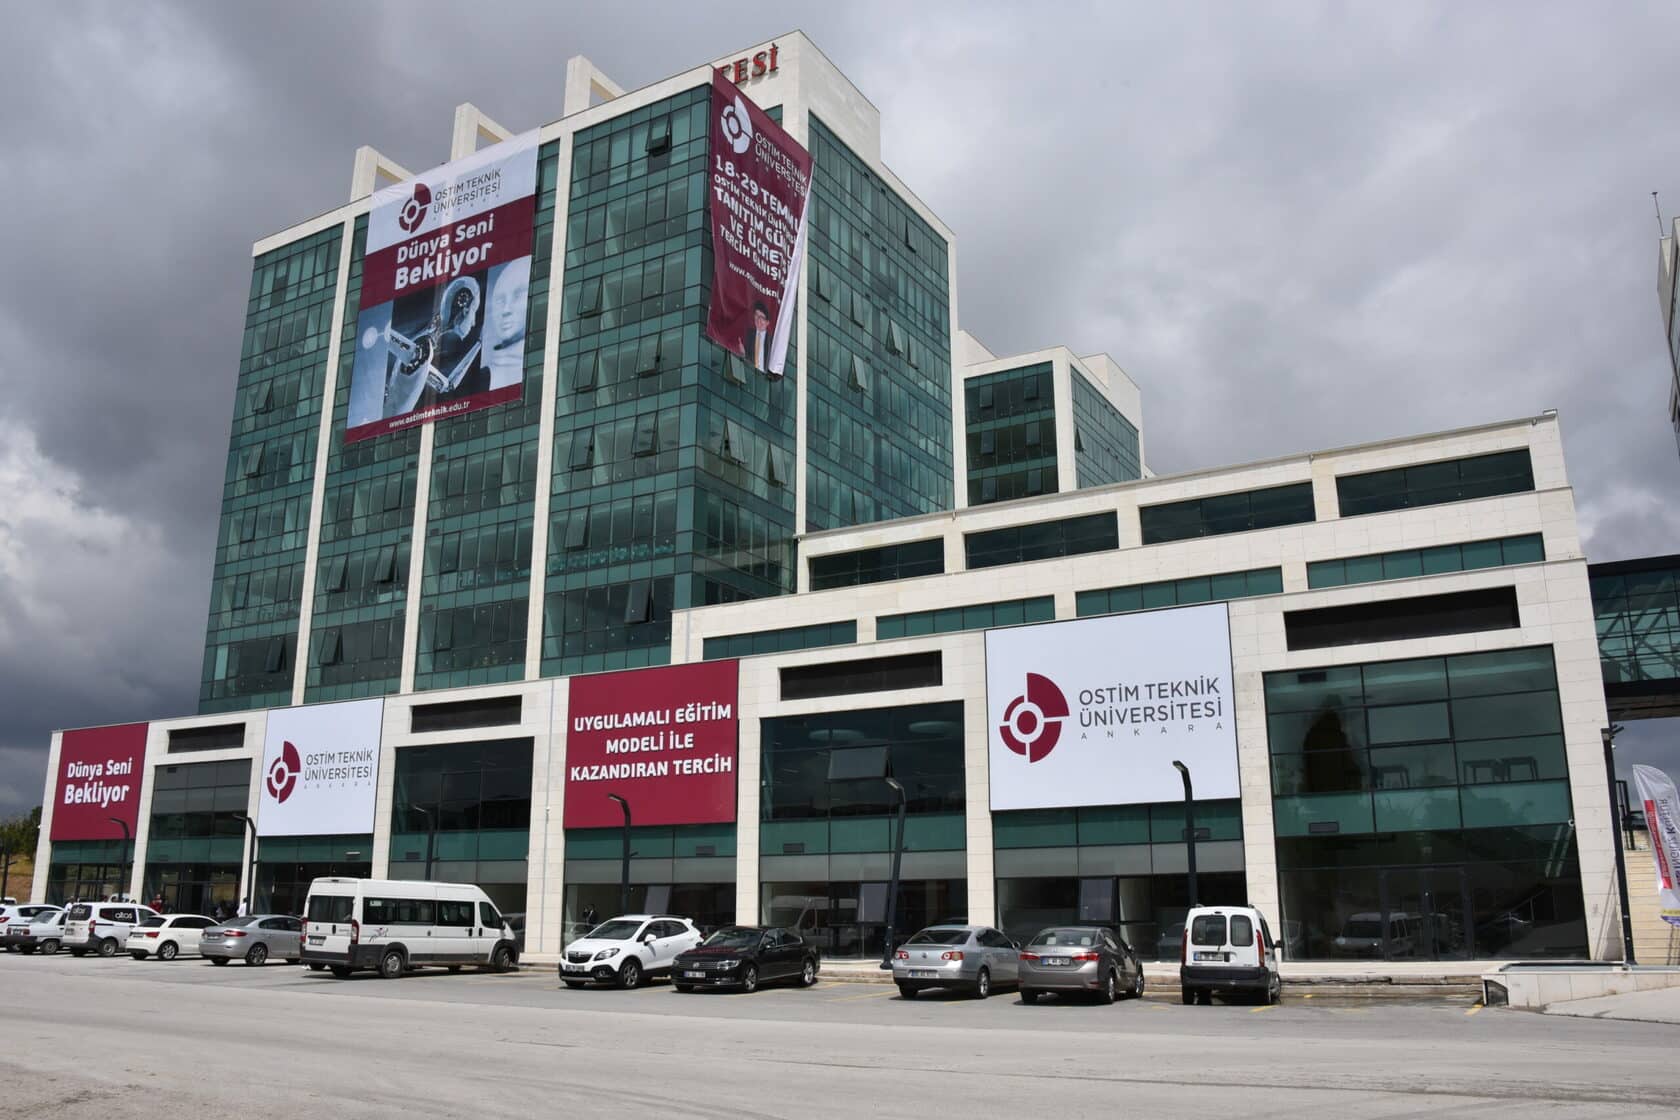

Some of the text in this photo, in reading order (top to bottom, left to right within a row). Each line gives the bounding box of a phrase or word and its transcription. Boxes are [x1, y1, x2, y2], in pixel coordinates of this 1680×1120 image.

[434, 182, 500, 214] ÜNİVERSİTESİ
[435, 168, 501, 201] OSTİM TEKNİK
[714, 174, 740, 196] OSTİM
[714, 185, 763, 234] TANITIM
[397, 213, 494, 264] Dünya Seni
[720, 224, 750, 258] TERCİH
[730, 215, 744, 240] VE
[395, 242, 493, 290] Bekliyor
[389, 401, 470, 428] www.ostimteknik.edu.tr
[1079, 675, 1220, 705] OSTİM TEKNİK
[574, 701, 731, 731] UYGULAMALI EĞİTİM
[1080, 696, 1222, 728] ÜNİVERSİTESİ
[606, 731, 694, 754] MODELİ İLE
[1081, 722, 1222, 740] ANKARA
[67, 757, 132, 781] Dünya Seni
[306, 747, 373, 766] OSTİM TEKNİK
[571, 753, 732, 781] KAZANDIRAN TERCİH
[305, 763, 373, 781] ÜNİVERSİTESİ
[64, 780, 130, 808] Bekliyor
